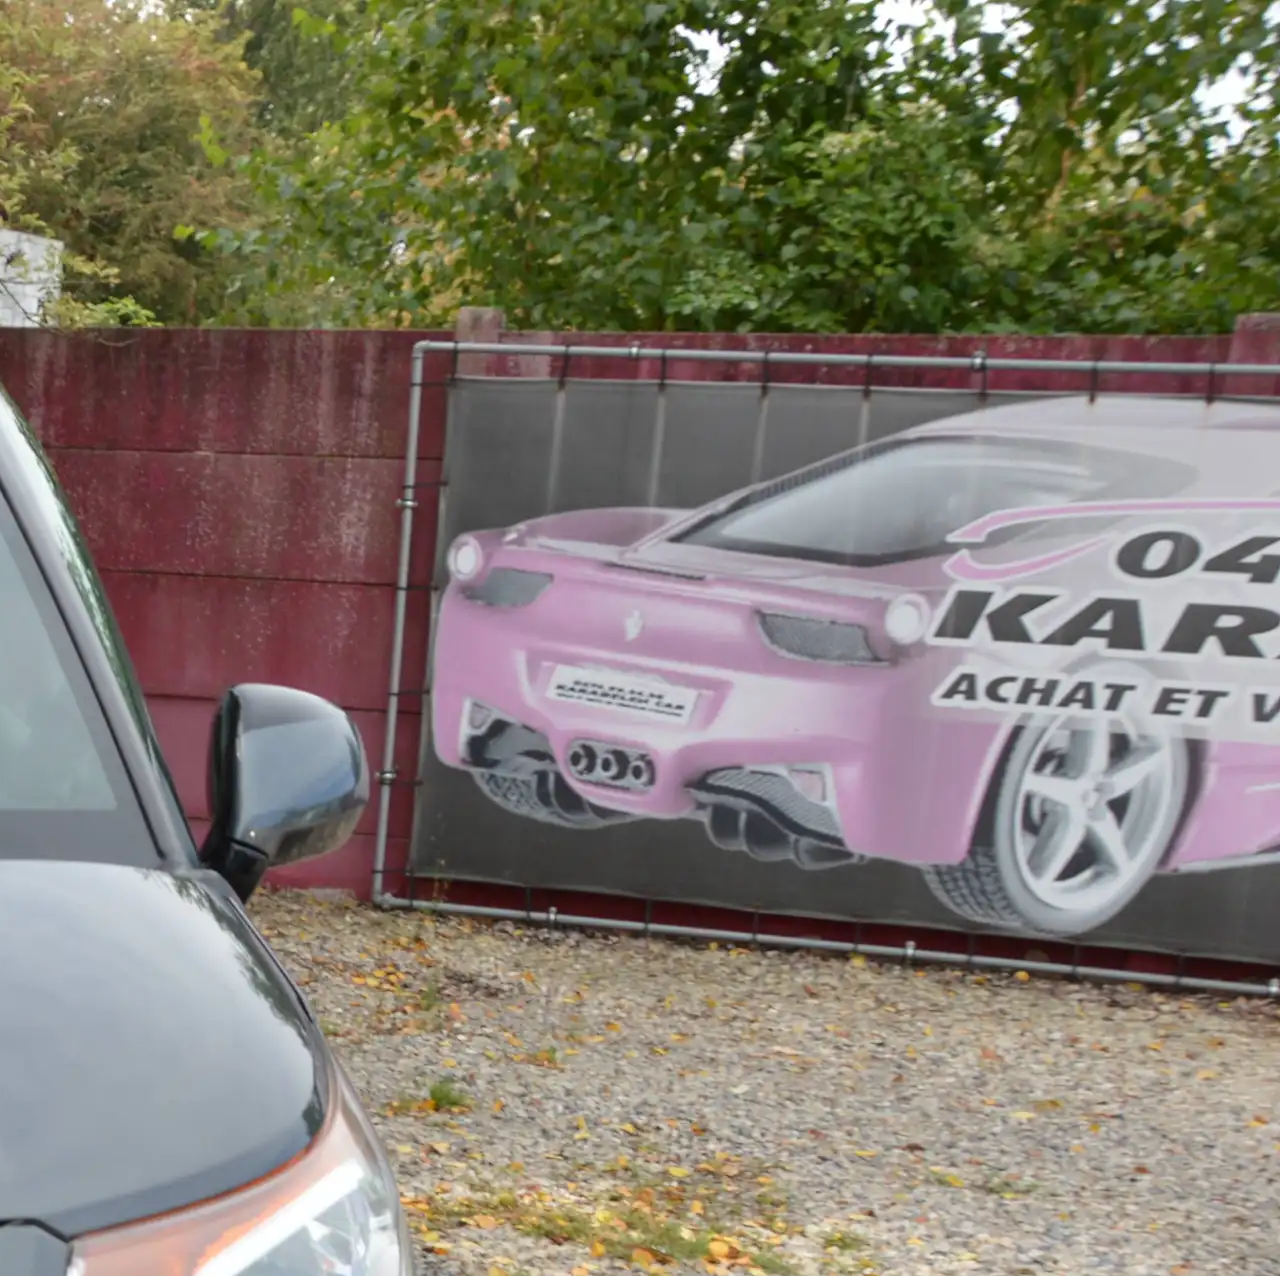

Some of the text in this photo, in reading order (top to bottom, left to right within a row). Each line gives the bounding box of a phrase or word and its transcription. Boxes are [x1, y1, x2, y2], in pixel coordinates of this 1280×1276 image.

[1116, 530, 1280, 584] 04
[933, 590, 1280, 660] KAR
[939, 672, 1137, 712] ACHAT
[1151, 687, 1230, 719] ET
